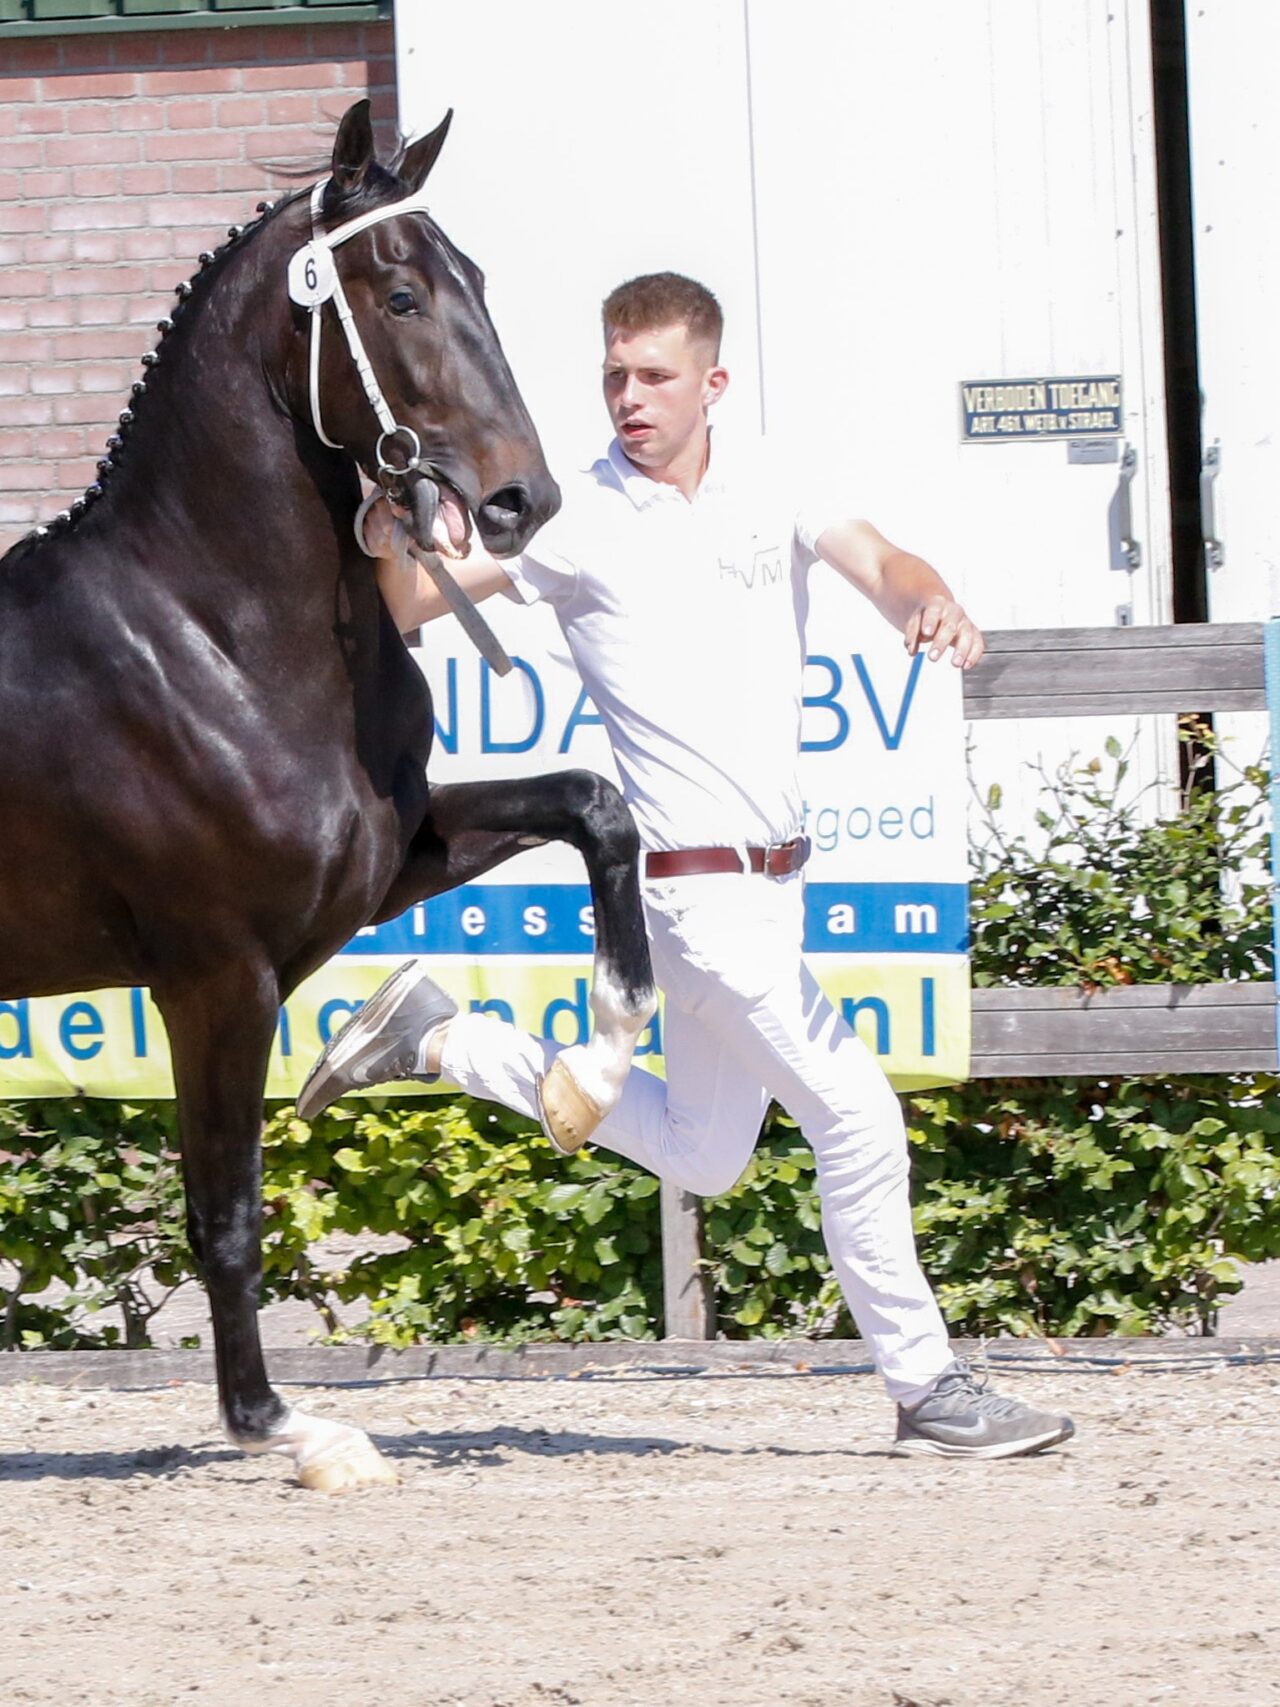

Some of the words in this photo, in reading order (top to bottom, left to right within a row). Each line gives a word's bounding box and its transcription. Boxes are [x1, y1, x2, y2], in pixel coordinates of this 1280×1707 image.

[304, 257, 318, 291] 6
[963, 384, 1047, 413] VERBODEN
[1048, 382, 1120, 410] TOEGANG
[799, 651, 926, 752] BV
